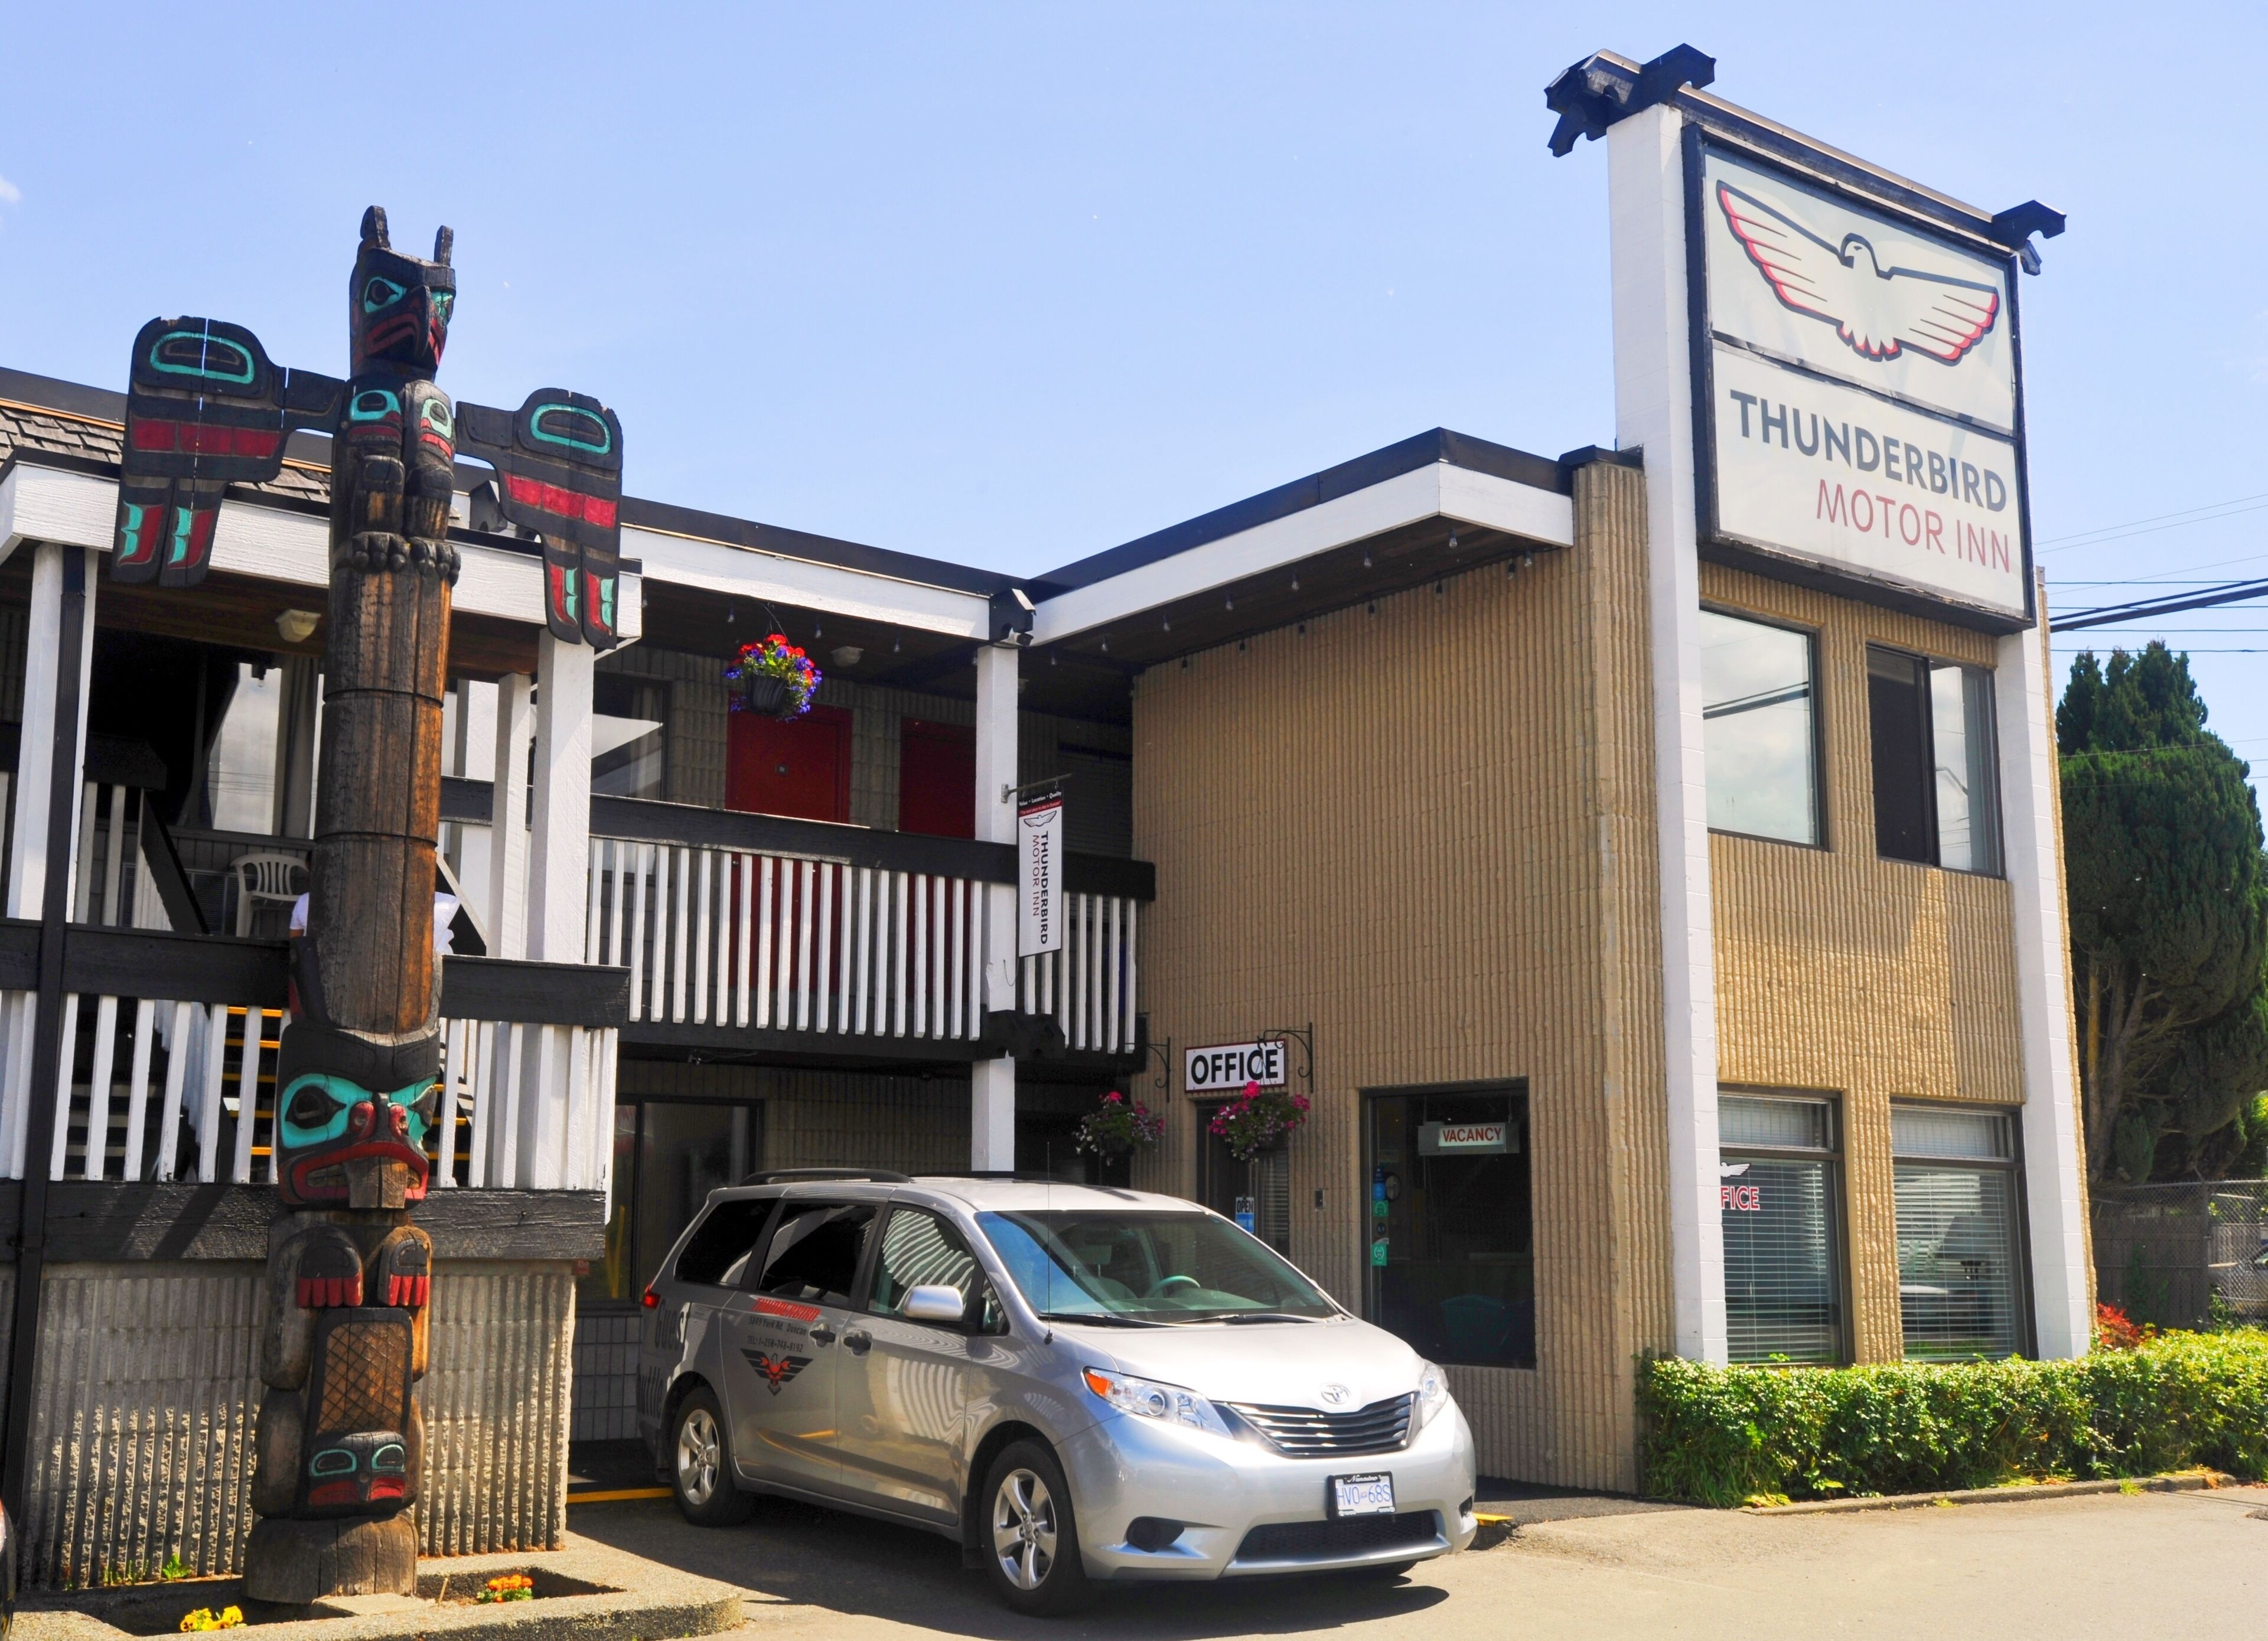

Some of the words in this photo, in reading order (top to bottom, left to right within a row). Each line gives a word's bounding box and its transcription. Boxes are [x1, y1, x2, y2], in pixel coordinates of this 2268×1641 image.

[1730, 389, 2006, 513] THUNDERBIRD
[1817, 479, 1945, 554] MOTOR
[1957, 520, 2009, 573] INN
[1191, 1049, 1278, 1085] OFFICE
[1442, 1127, 1502, 1143] VACANCY
[1237, 1200, 1254, 1213] OPEN
[1720, 1186, 1761, 1211] FICE
[786, 1323, 807, 1336] Duncan
